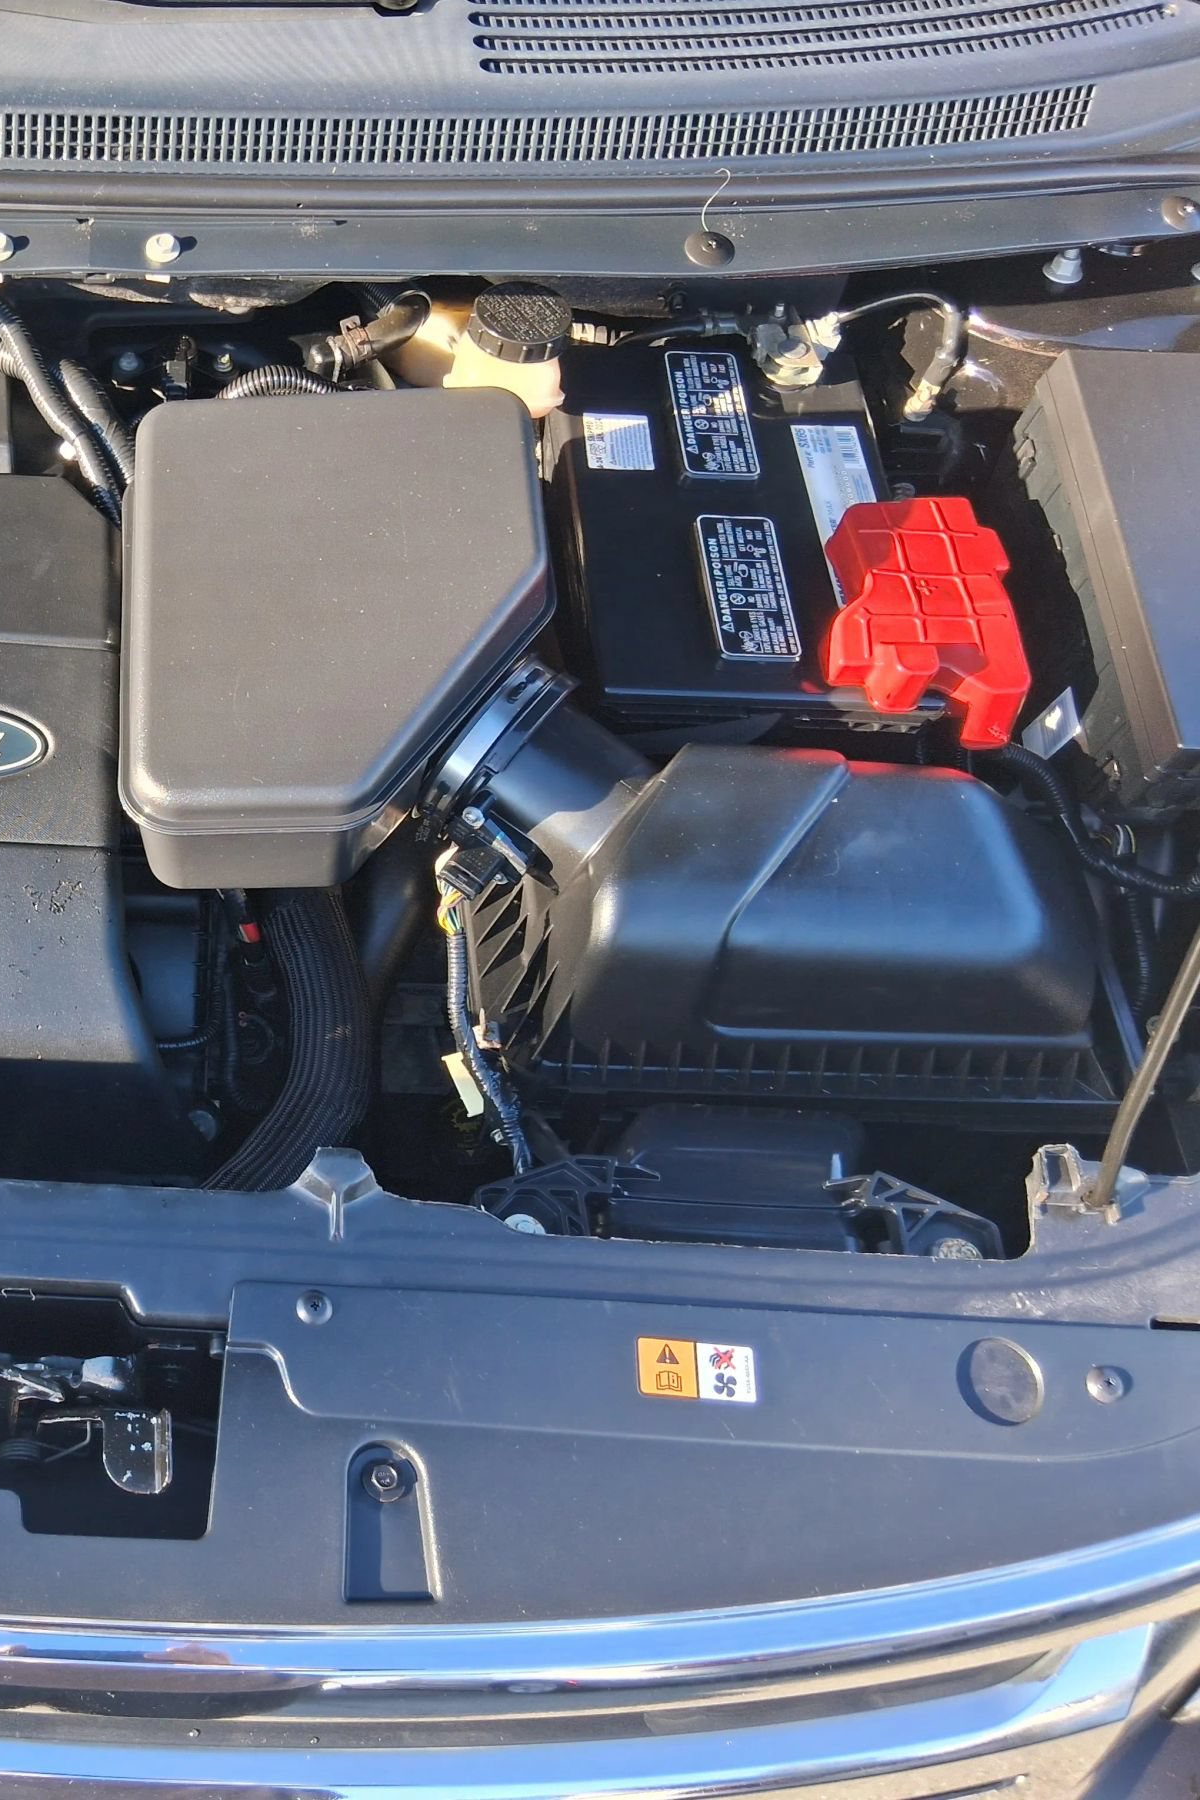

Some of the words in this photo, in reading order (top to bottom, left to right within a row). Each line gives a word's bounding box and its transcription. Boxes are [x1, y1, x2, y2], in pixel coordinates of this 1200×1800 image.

[675, 371, 697, 444] DANGER/POISON
[796, 428, 809, 447] SX65
[806, 453, 816, 468] Part
[708, 538, 732, 622] DANGER/POISON
[756, 612, 766, 626] GASES
